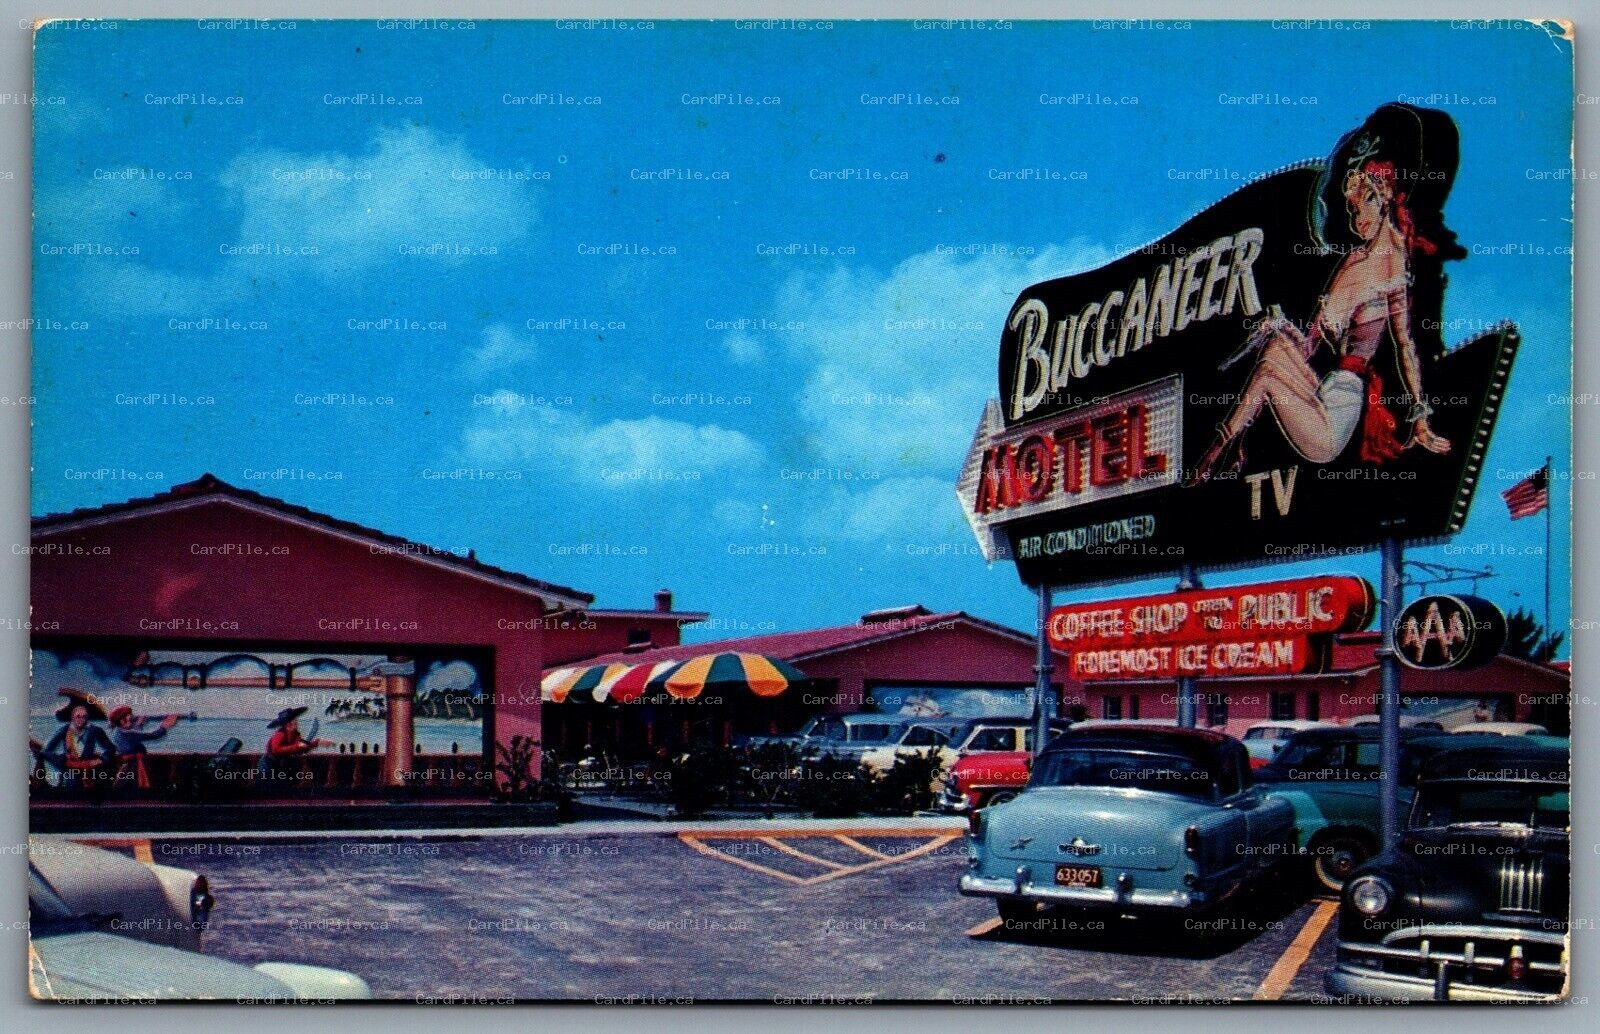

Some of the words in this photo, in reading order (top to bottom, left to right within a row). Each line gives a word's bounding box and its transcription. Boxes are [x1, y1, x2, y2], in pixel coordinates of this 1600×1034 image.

[1009, 227, 1264, 420] BUCCANEER
[974, 403, 1167, 514] MOTEL
[1244, 464, 1298, 520] TV
[1018, 535, 1042, 558] AIR
[1052, 608, 1125, 641] COFFEE
[1130, 602, 1188, 634] SHOP
[1238, 586, 1334, 626] PUBLIC
[1403, 601, 1467, 663] AAA
[1074, 646, 1172, 674] FOREMOST
[1175, 644, 1208, 671] ICE
[1211, 640, 1294, 670] CREAM
